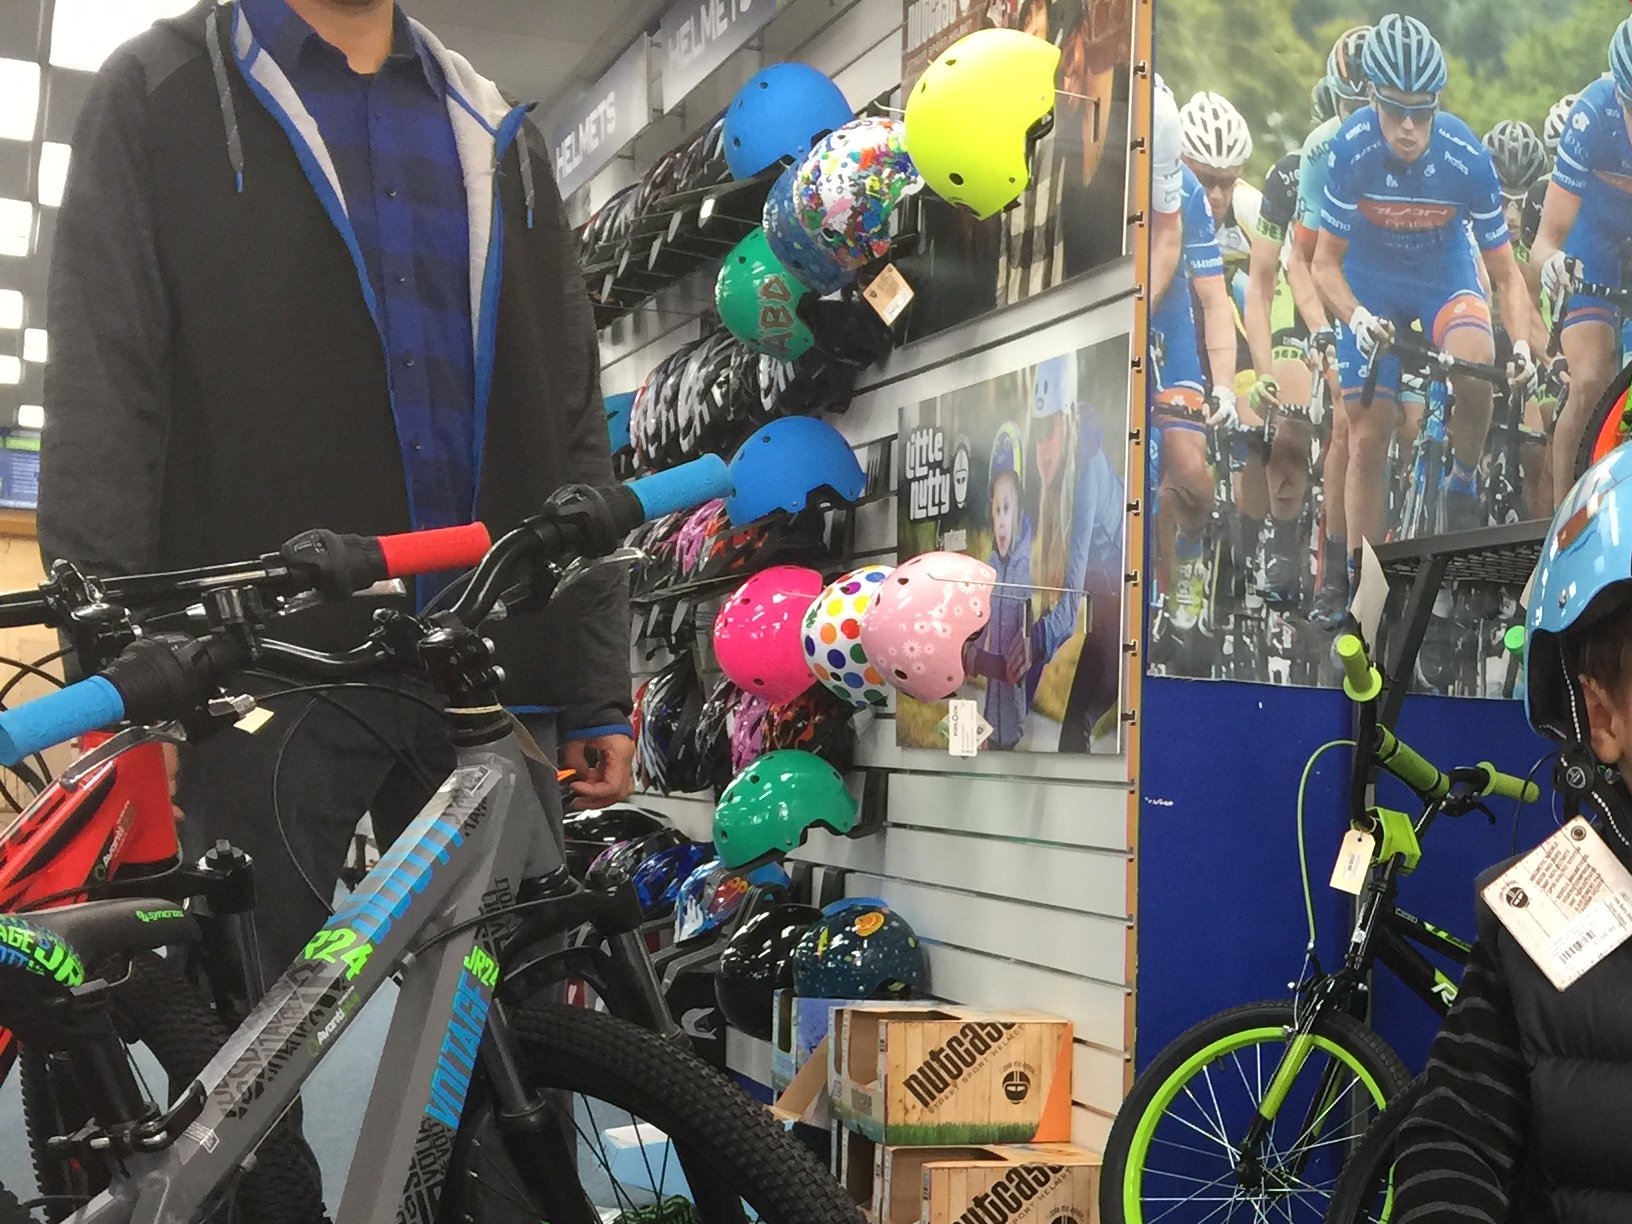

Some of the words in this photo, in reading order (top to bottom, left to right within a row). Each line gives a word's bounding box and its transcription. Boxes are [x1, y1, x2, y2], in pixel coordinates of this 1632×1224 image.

[555, 91, 616, 180] HELMETS
[311, 1007, 349, 1047] Avanti
[962, 1057, 989, 1083] SPORT
[991, 1023, 1025, 1056] HELMET
[1036, 1168, 1073, 1202] HELMET
